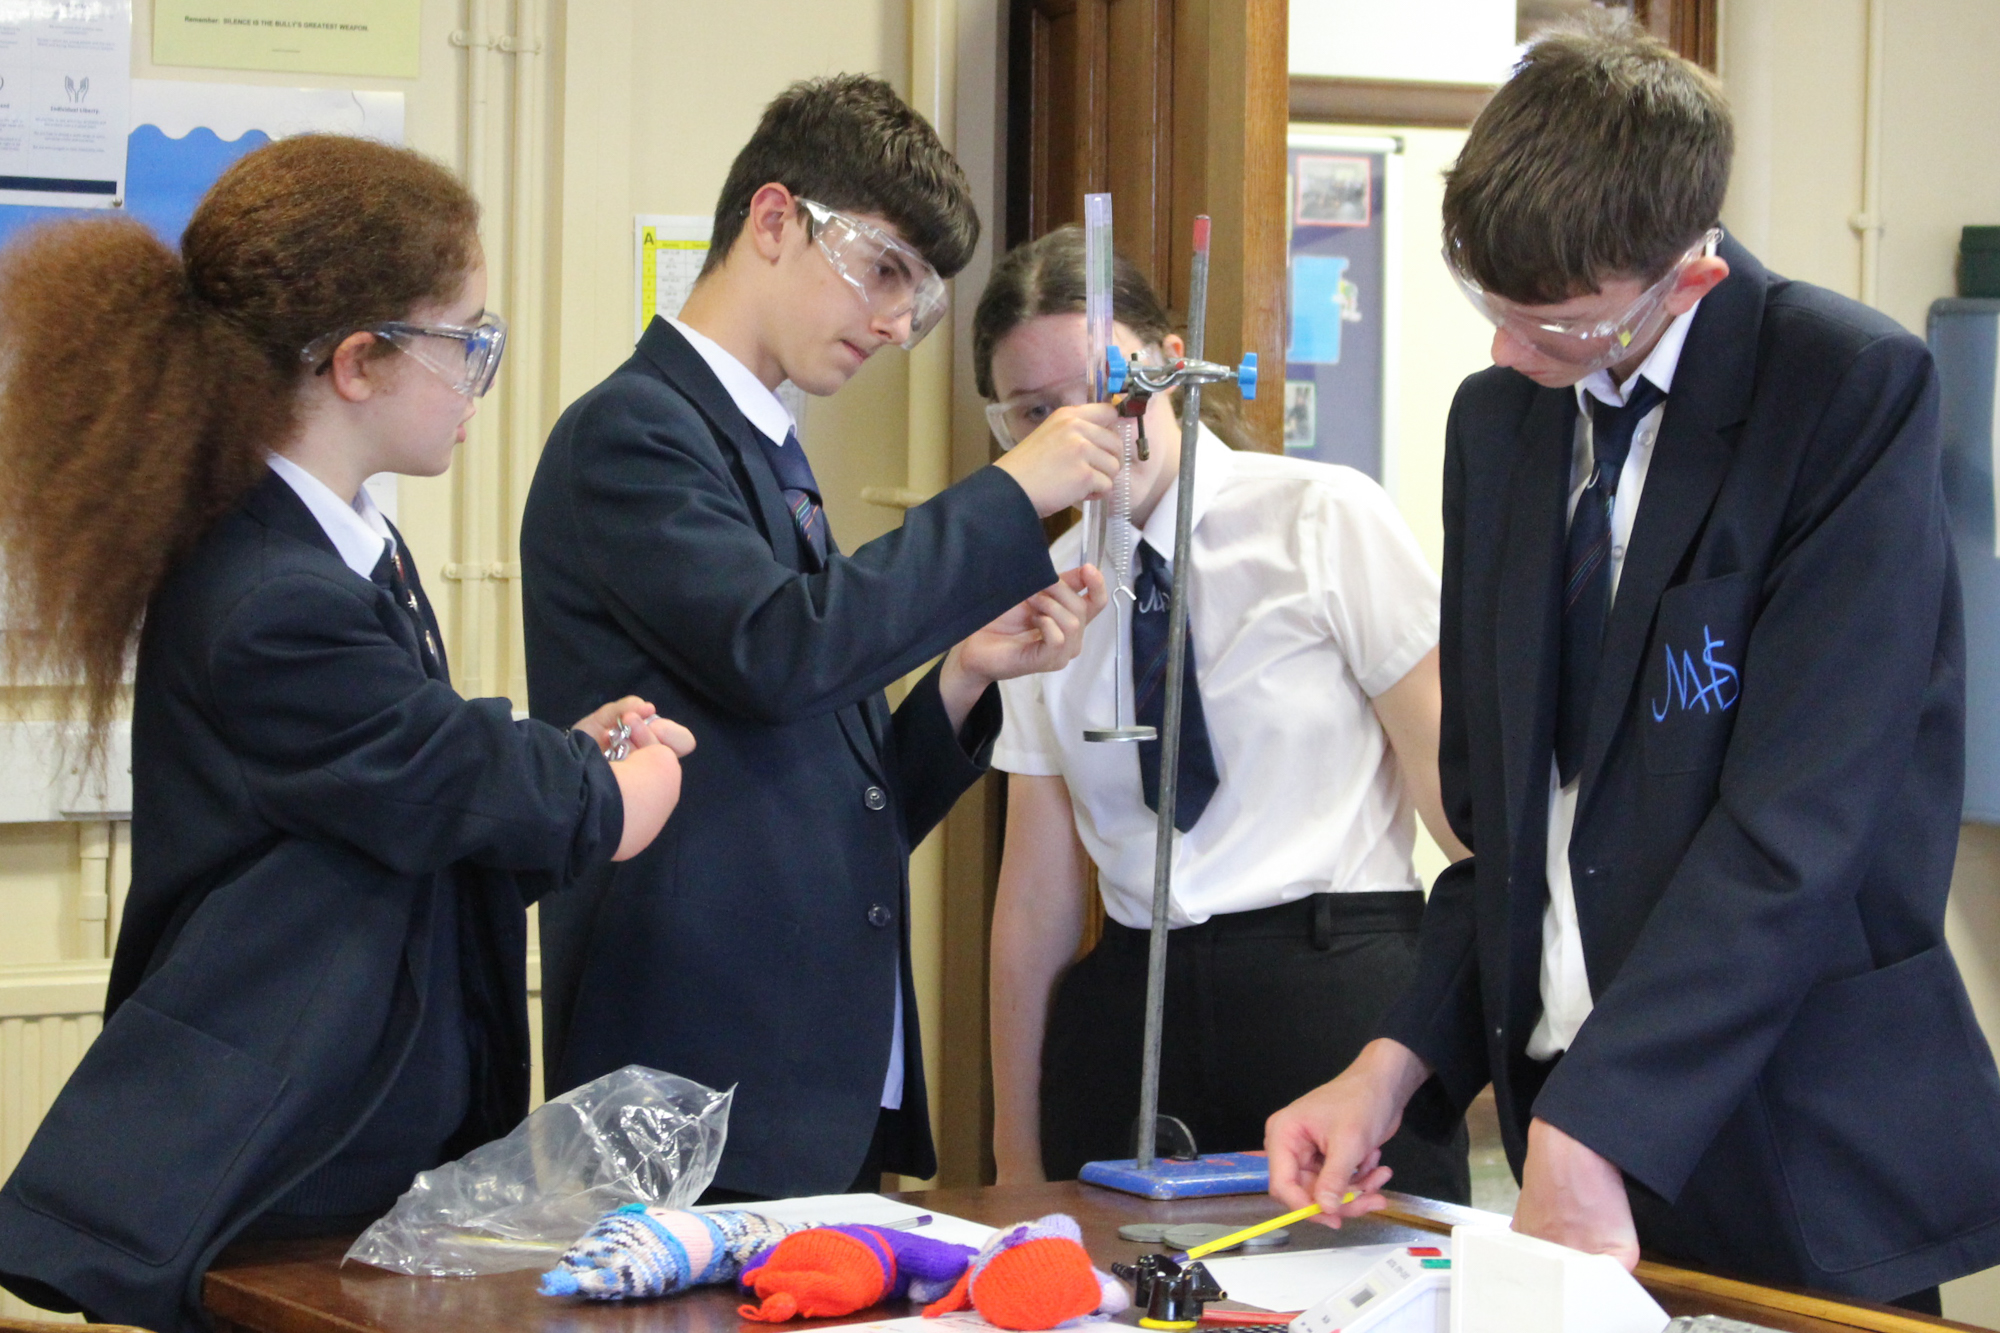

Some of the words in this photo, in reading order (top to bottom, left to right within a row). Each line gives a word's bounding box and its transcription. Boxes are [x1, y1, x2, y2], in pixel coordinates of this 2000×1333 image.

[223, 17, 251, 26] SILENCE
[261, 19, 273, 27] THE
[274, 20, 302, 28] BULLY'S
[303, 22, 338, 30] GREATEST
[644, 232, 654, 245] A
